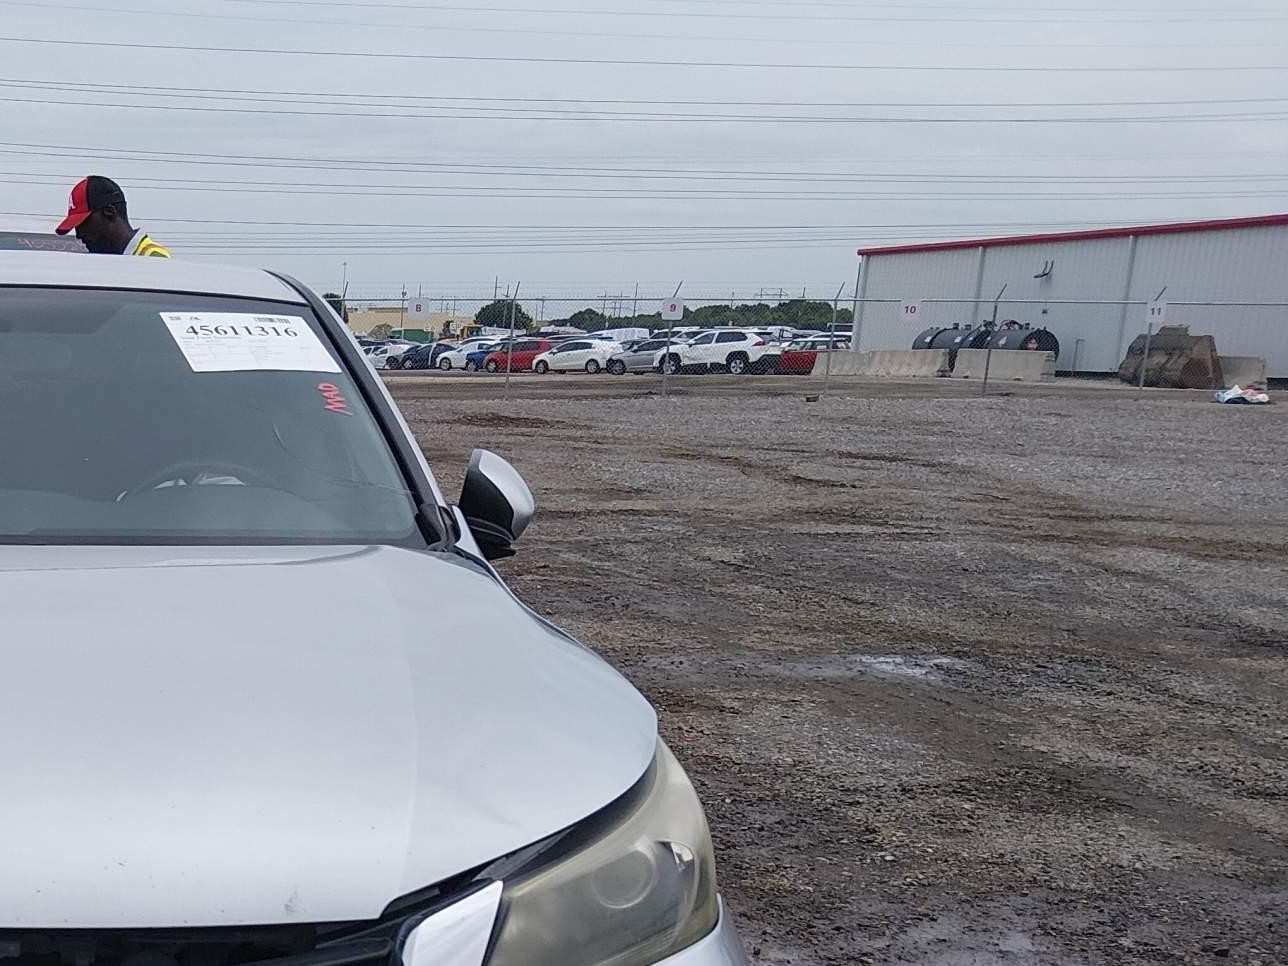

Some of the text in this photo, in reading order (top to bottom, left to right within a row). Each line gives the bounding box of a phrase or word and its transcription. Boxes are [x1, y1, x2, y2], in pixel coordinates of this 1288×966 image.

[415, 304, 422, 312] 8
[670, 304, 677, 312] 9
[1151, 307, 1161, 315] 11
[186, 325, 297, 337] 45611316
